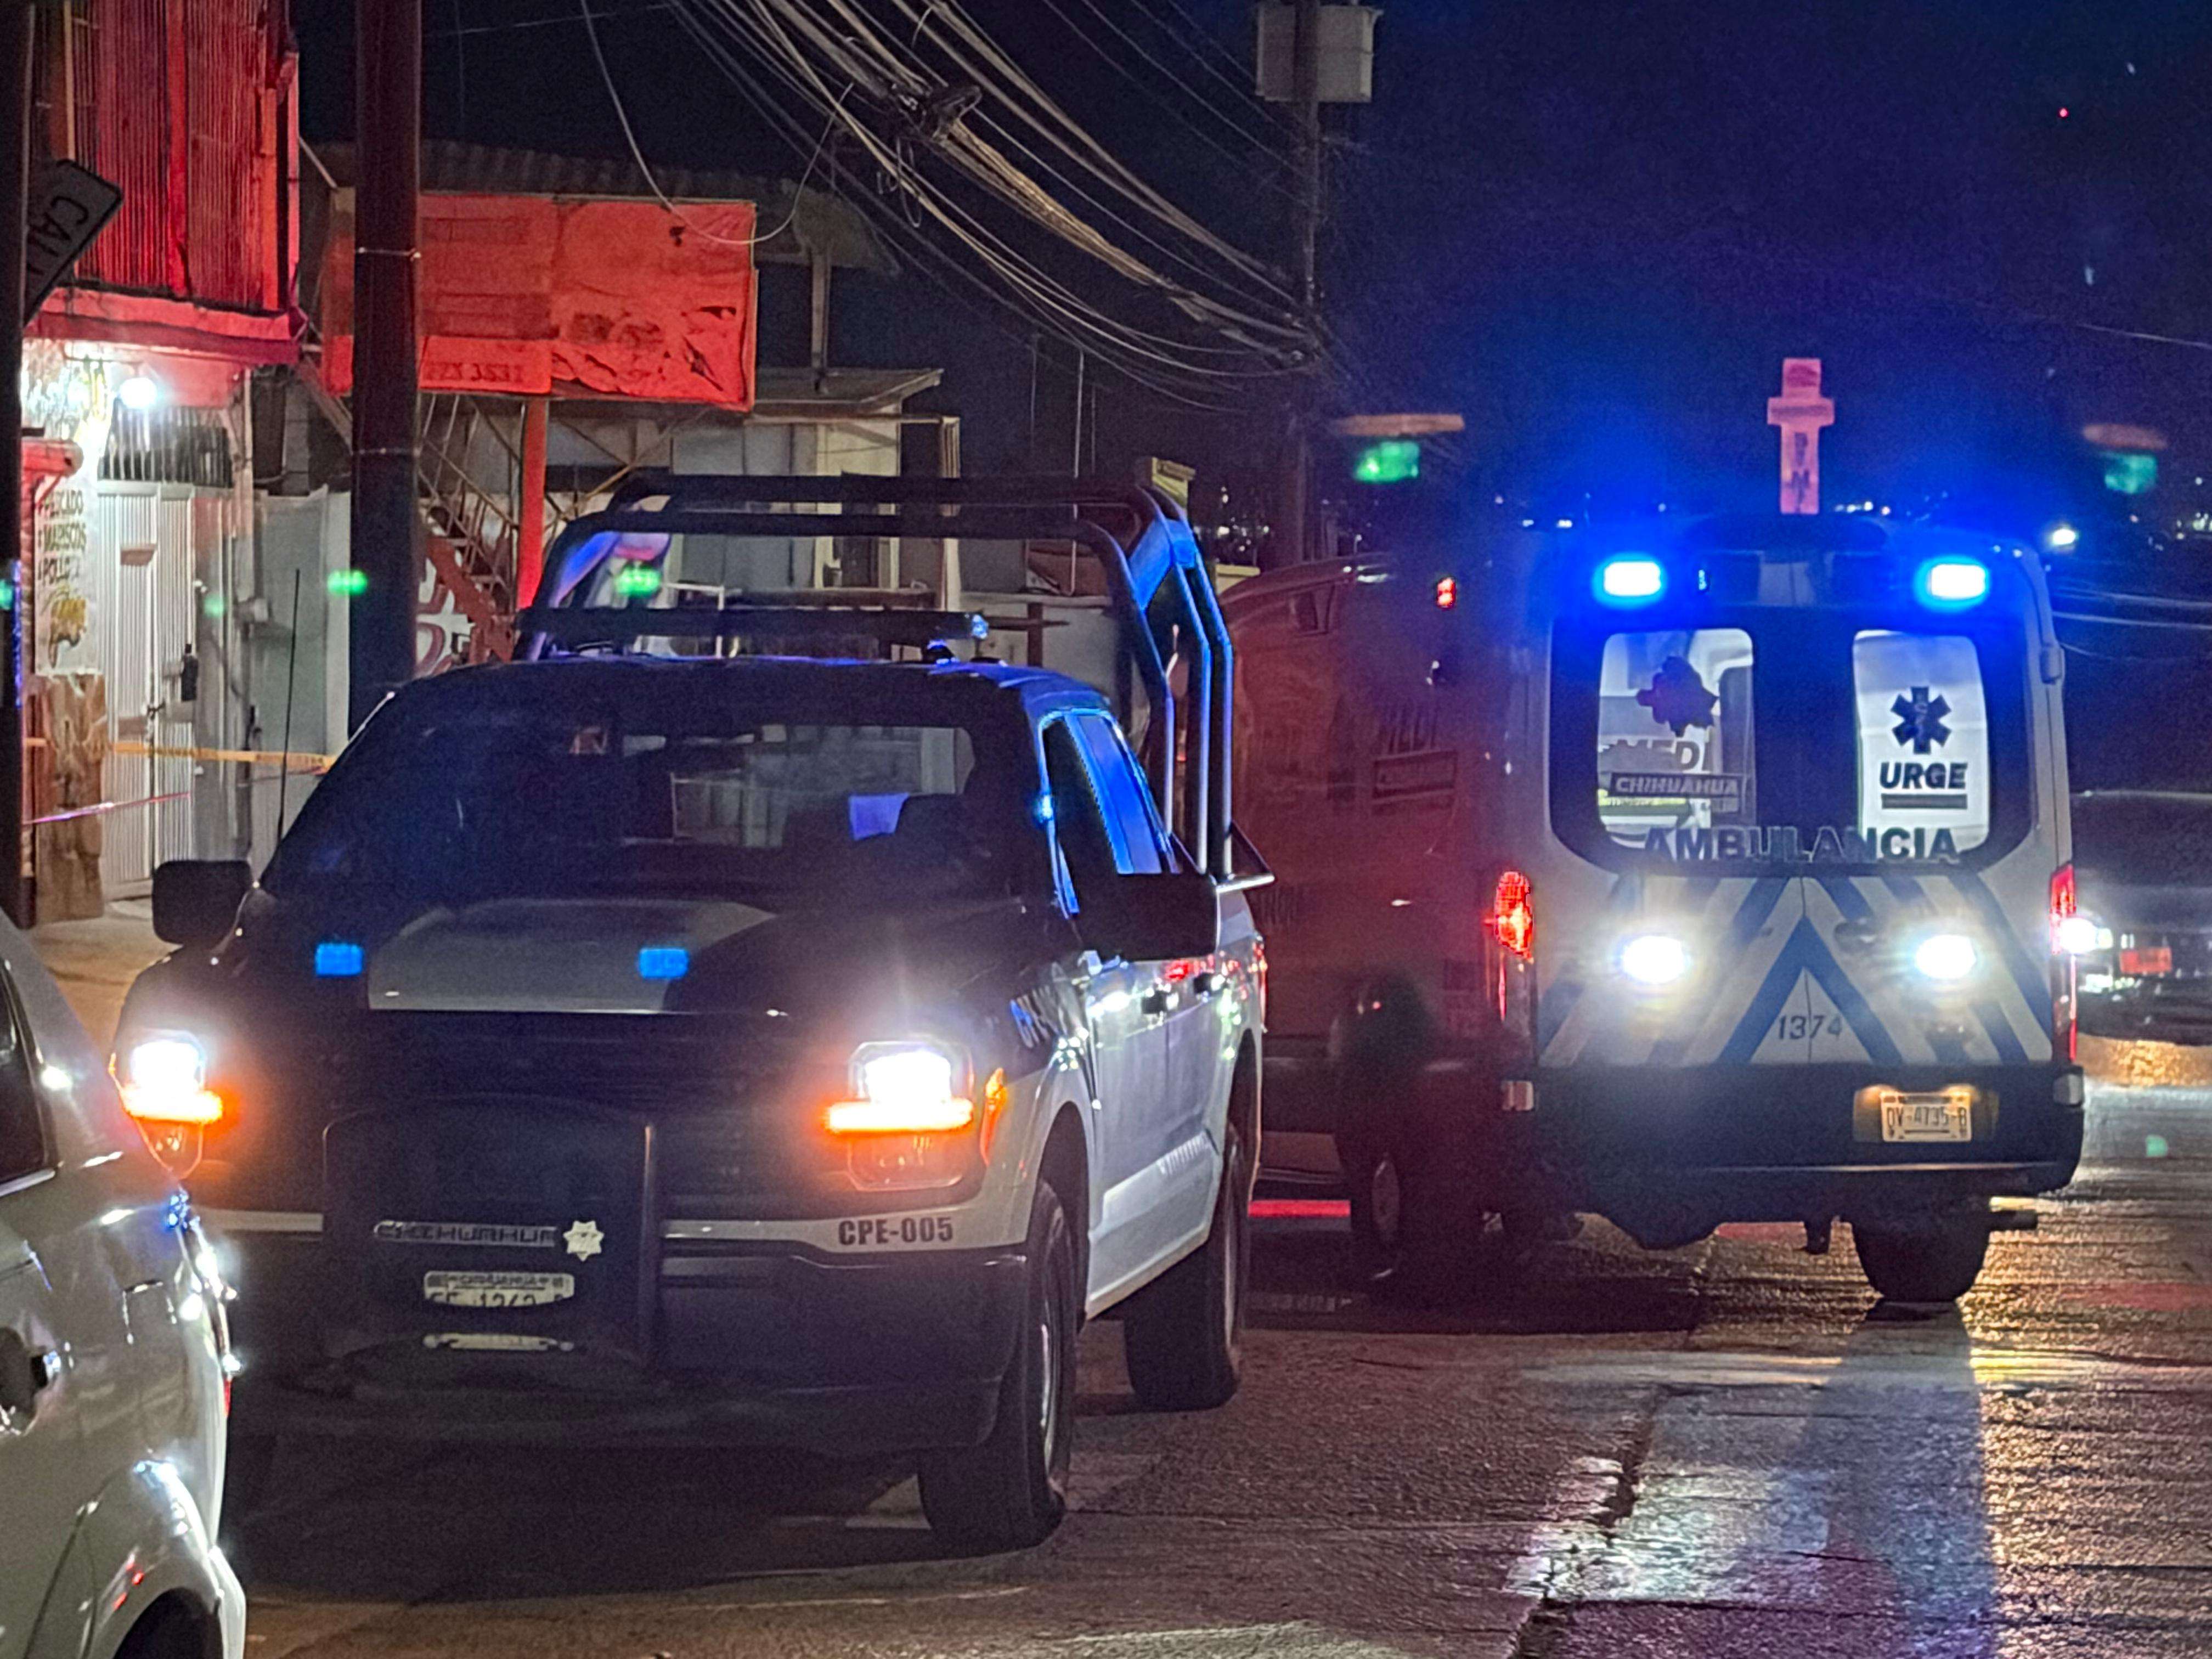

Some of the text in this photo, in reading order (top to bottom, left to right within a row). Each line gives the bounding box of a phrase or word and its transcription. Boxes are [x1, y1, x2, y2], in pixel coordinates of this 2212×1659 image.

[1616, 777, 1738, 794] CHIHUAHUA
[1880, 762, 1968, 789] URGE
[1643, 825, 1960, 862] AMBULANCIA
[1779, 1014, 1843, 1041] 1374
[839, 1217, 953, 1245] CPE-005
